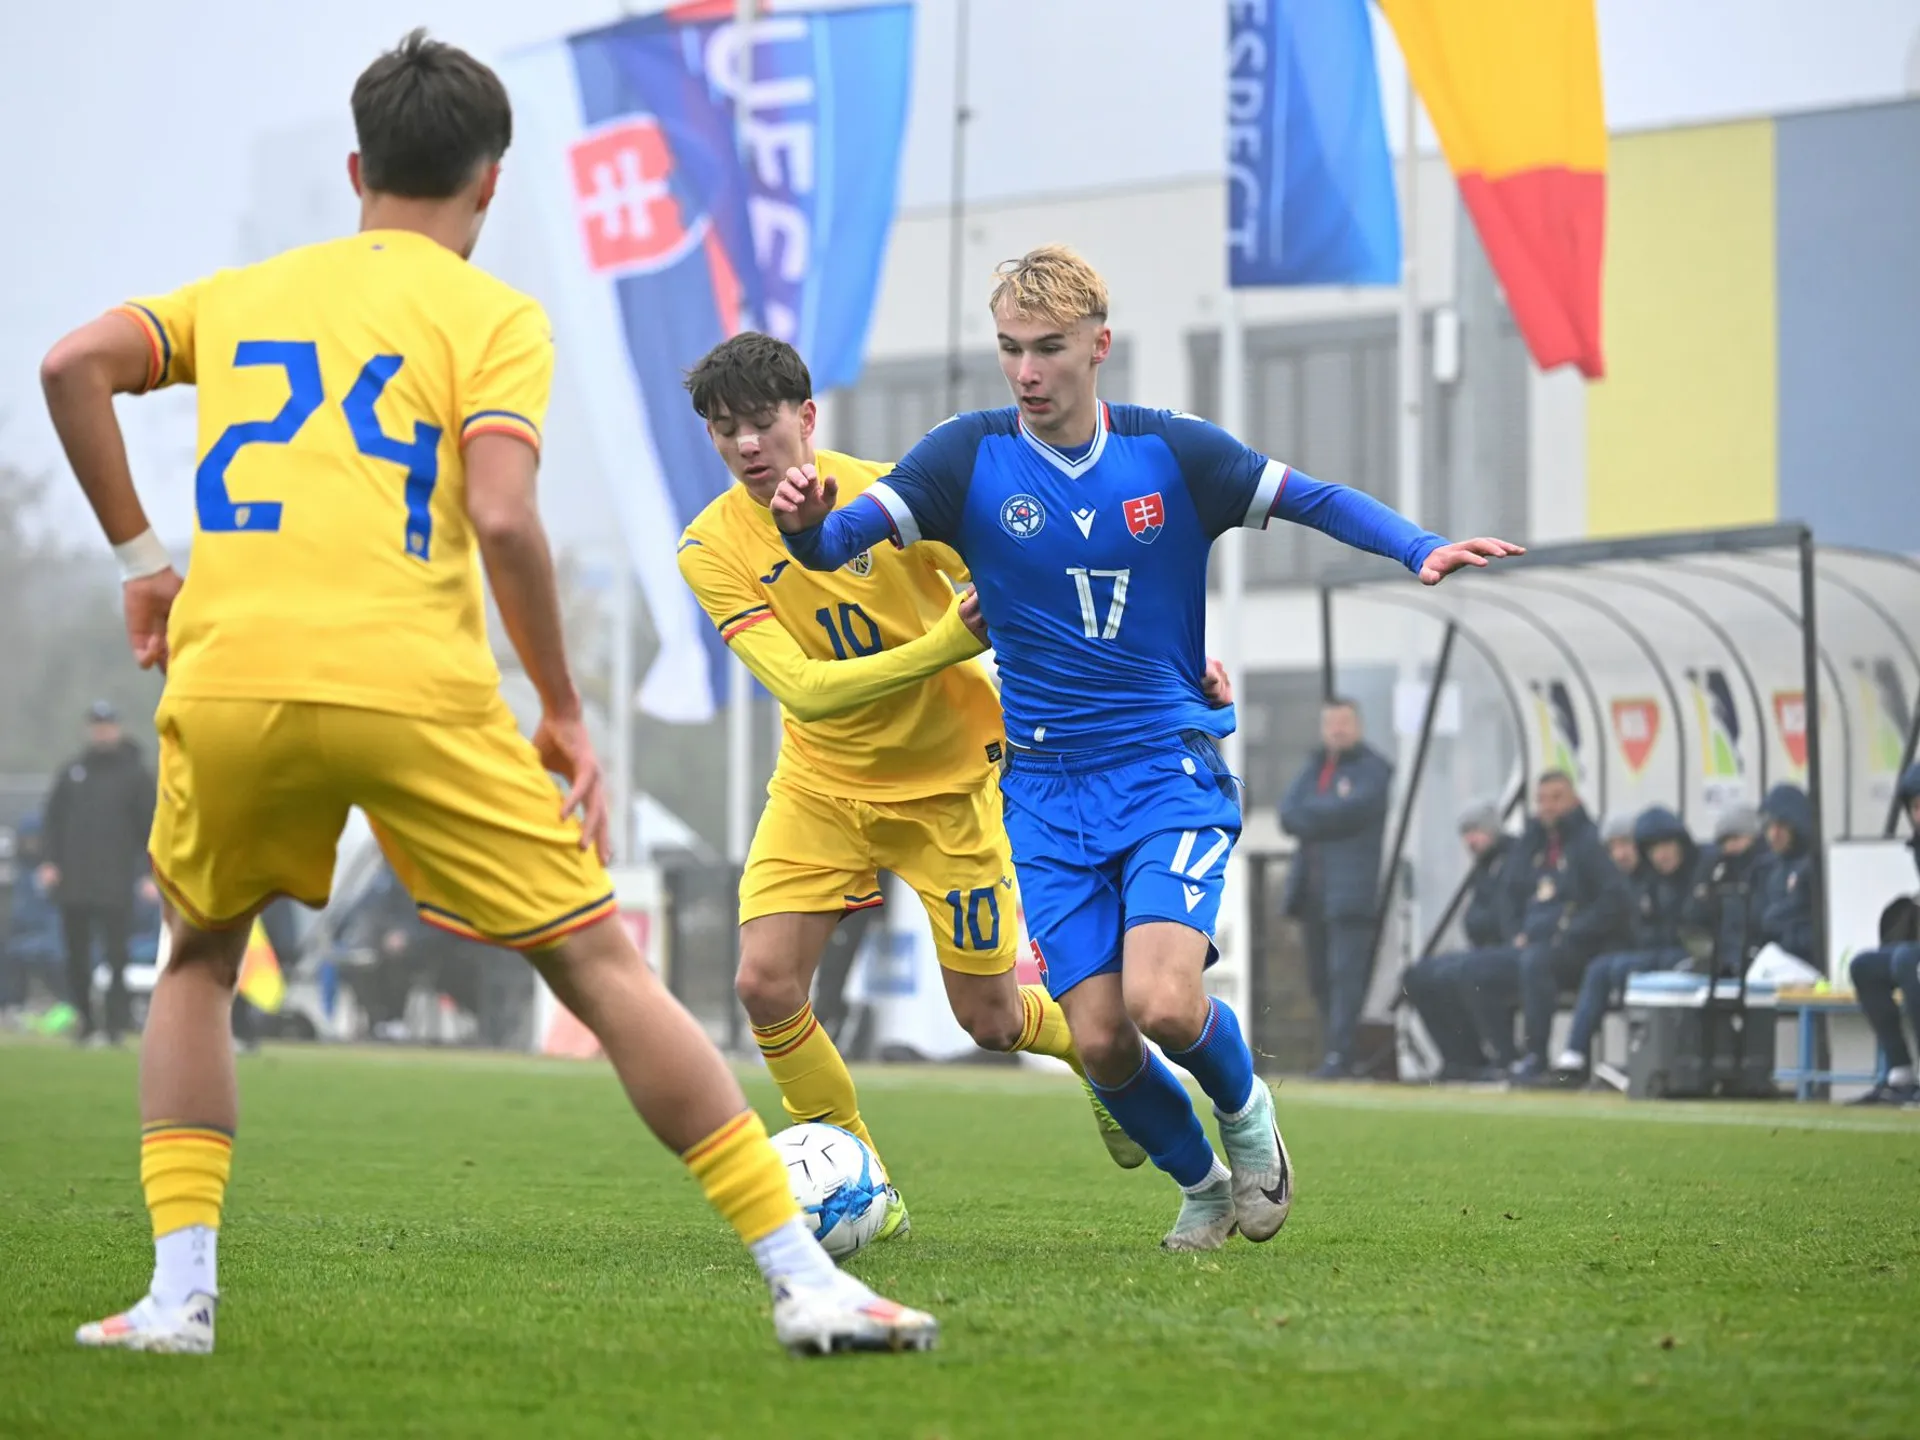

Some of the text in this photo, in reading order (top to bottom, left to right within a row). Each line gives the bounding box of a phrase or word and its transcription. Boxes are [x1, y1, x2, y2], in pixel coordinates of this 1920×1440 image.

[196, 341, 442, 562] 24
[816, 603, 883, 660] 10
[1066, 568, 1130, 640] 17
[1169, 827, 1230, 880] 17
[945, 886, 1000, 950] 10
